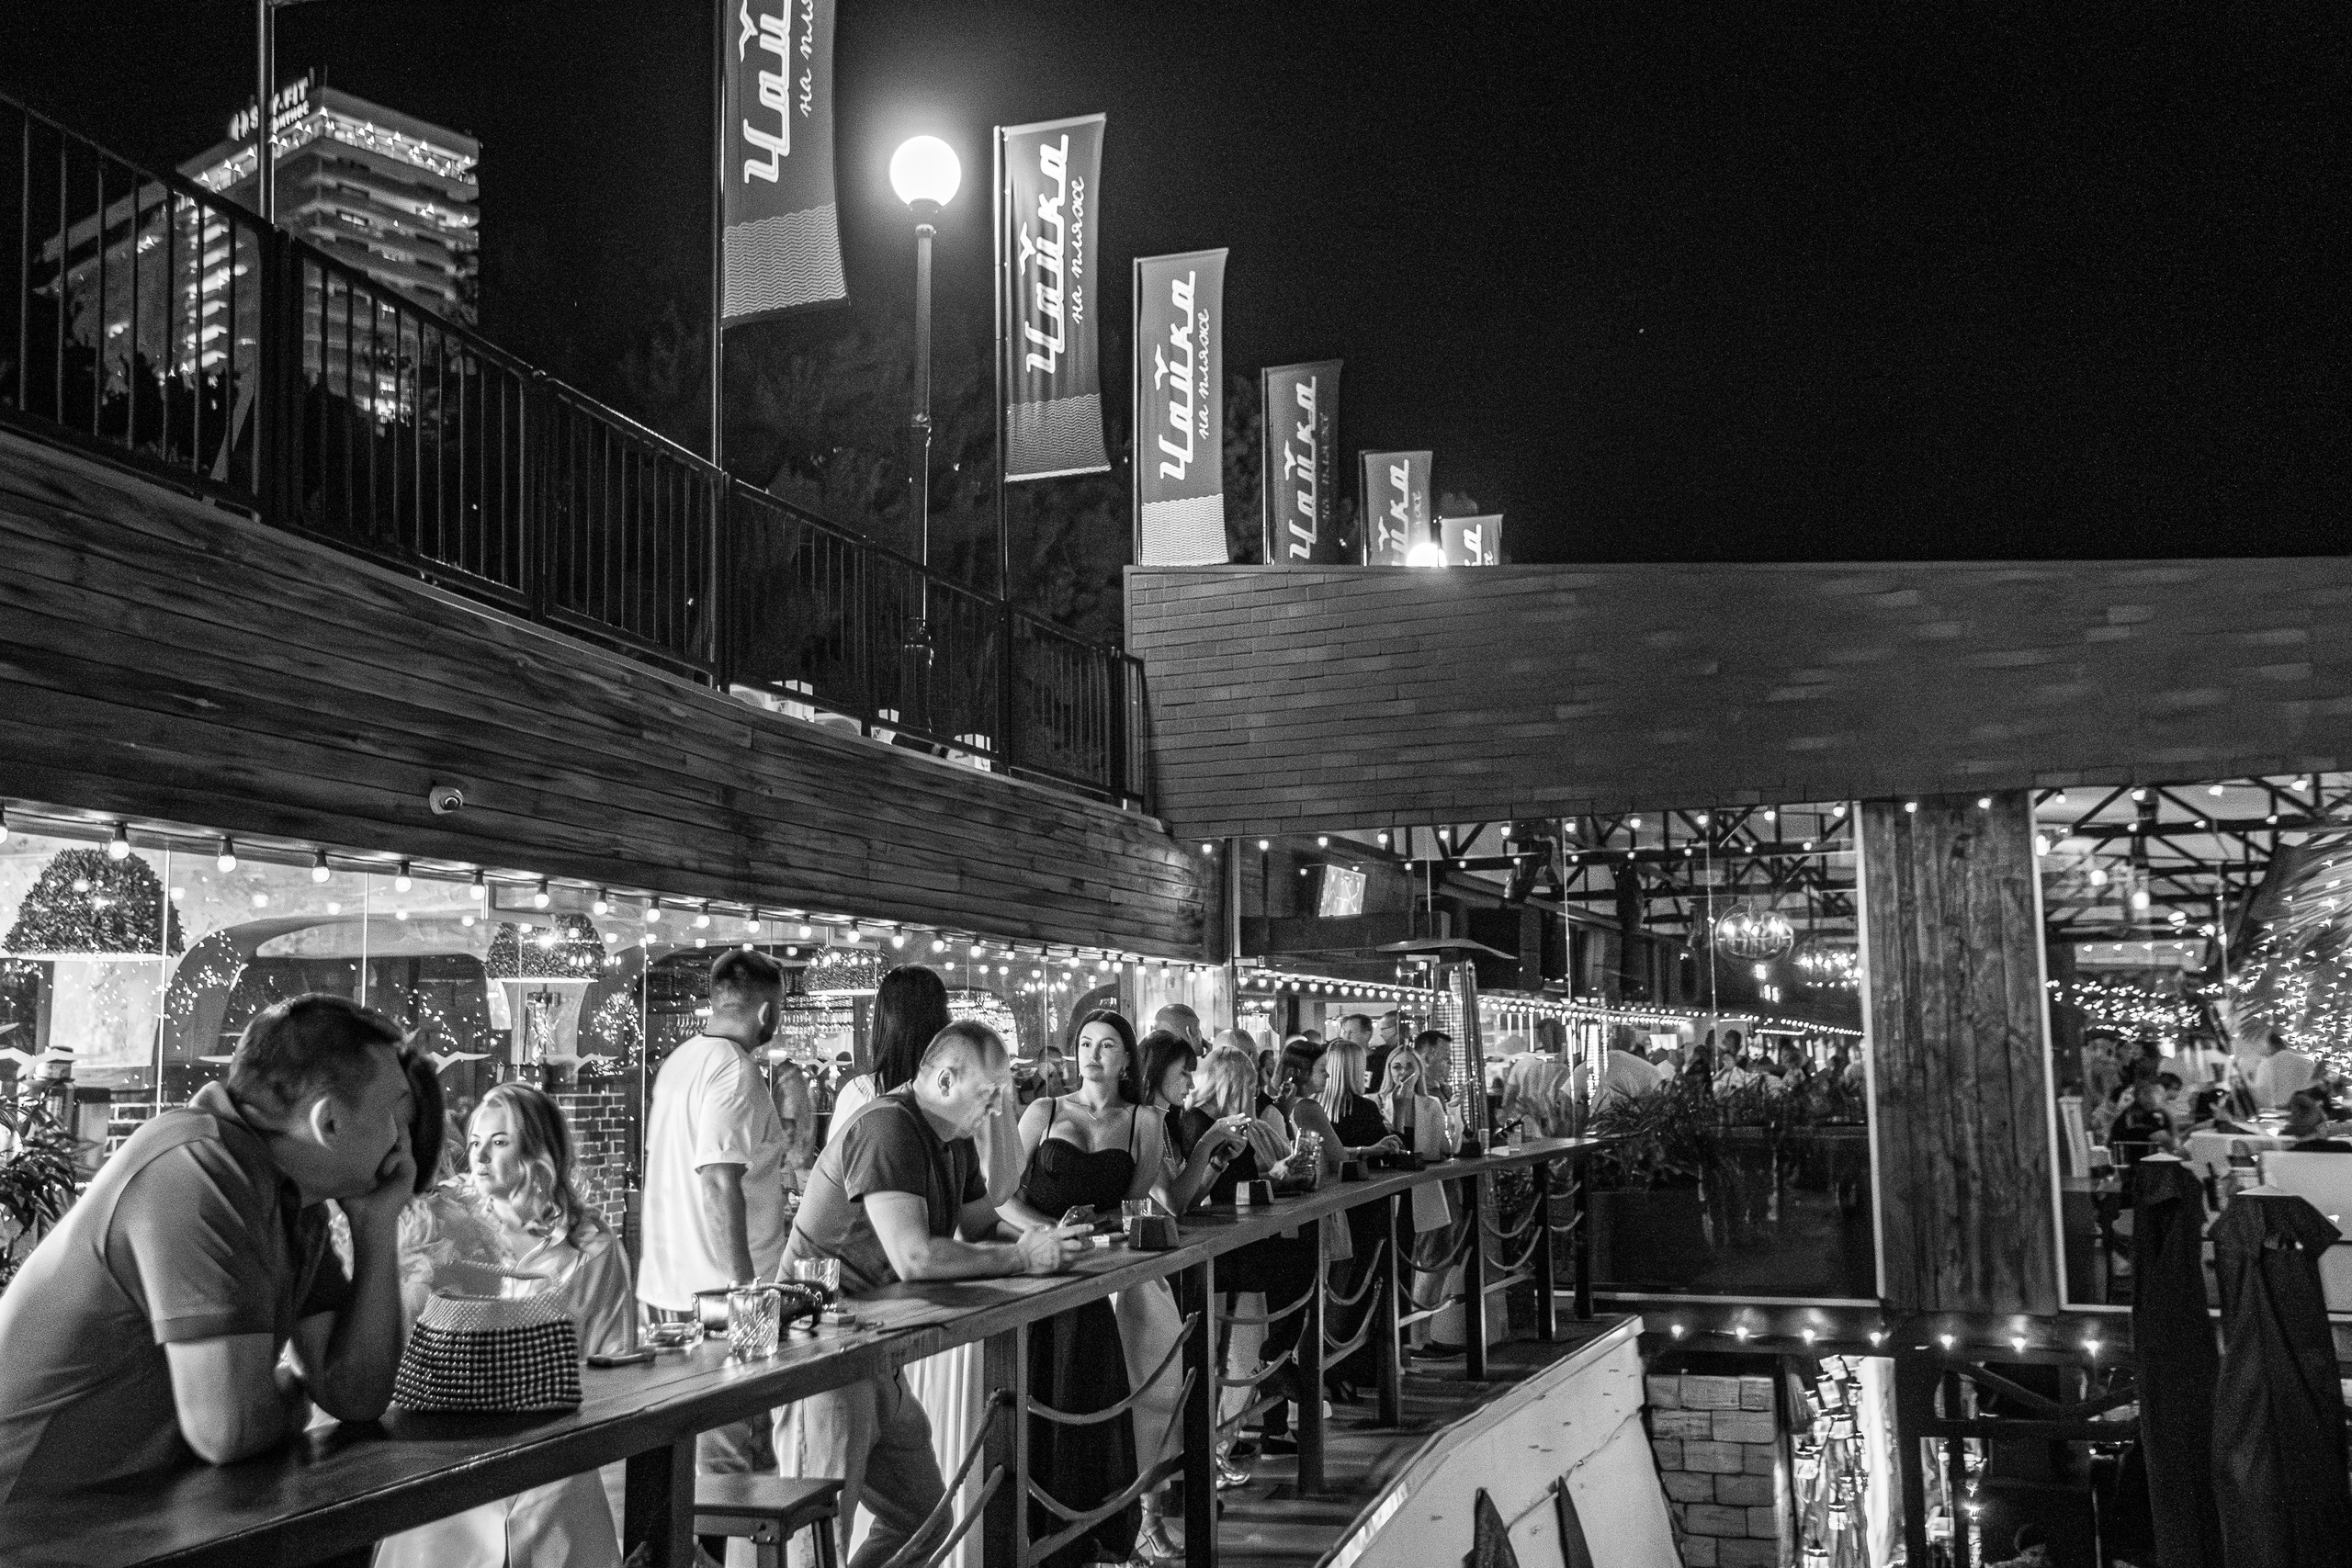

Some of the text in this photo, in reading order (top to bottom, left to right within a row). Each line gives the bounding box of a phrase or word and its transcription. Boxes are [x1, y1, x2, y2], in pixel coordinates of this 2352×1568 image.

[799, 68, 812, 118] на
[1019, 134, 1069, 375] Чайка
[1071, 175, 1085, 325] на пляже
[1154, 271, 1196, 480] Чайка
[1198, 308, 1210, 440] на пляже
[1284, 376, 1317, 559] Чайка
